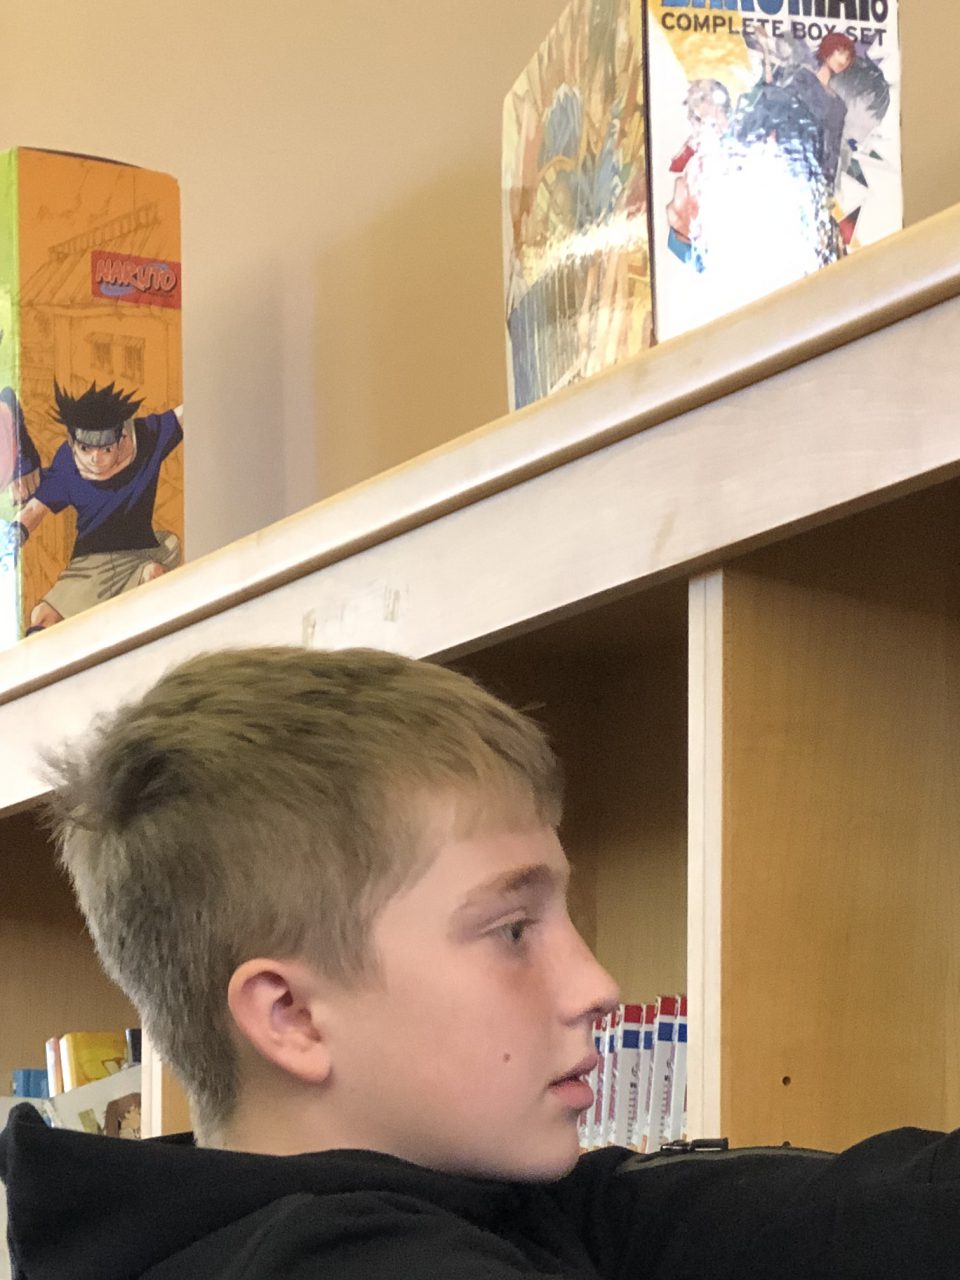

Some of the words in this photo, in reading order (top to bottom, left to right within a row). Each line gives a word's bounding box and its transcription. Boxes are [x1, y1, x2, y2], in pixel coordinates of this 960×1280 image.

[661, 12, 784, 37] COMPLETE
[791, 22, 836, 41] BOX
[846, 25, 887, 46] SET
[96, 255, 178, 293] NARUTO
